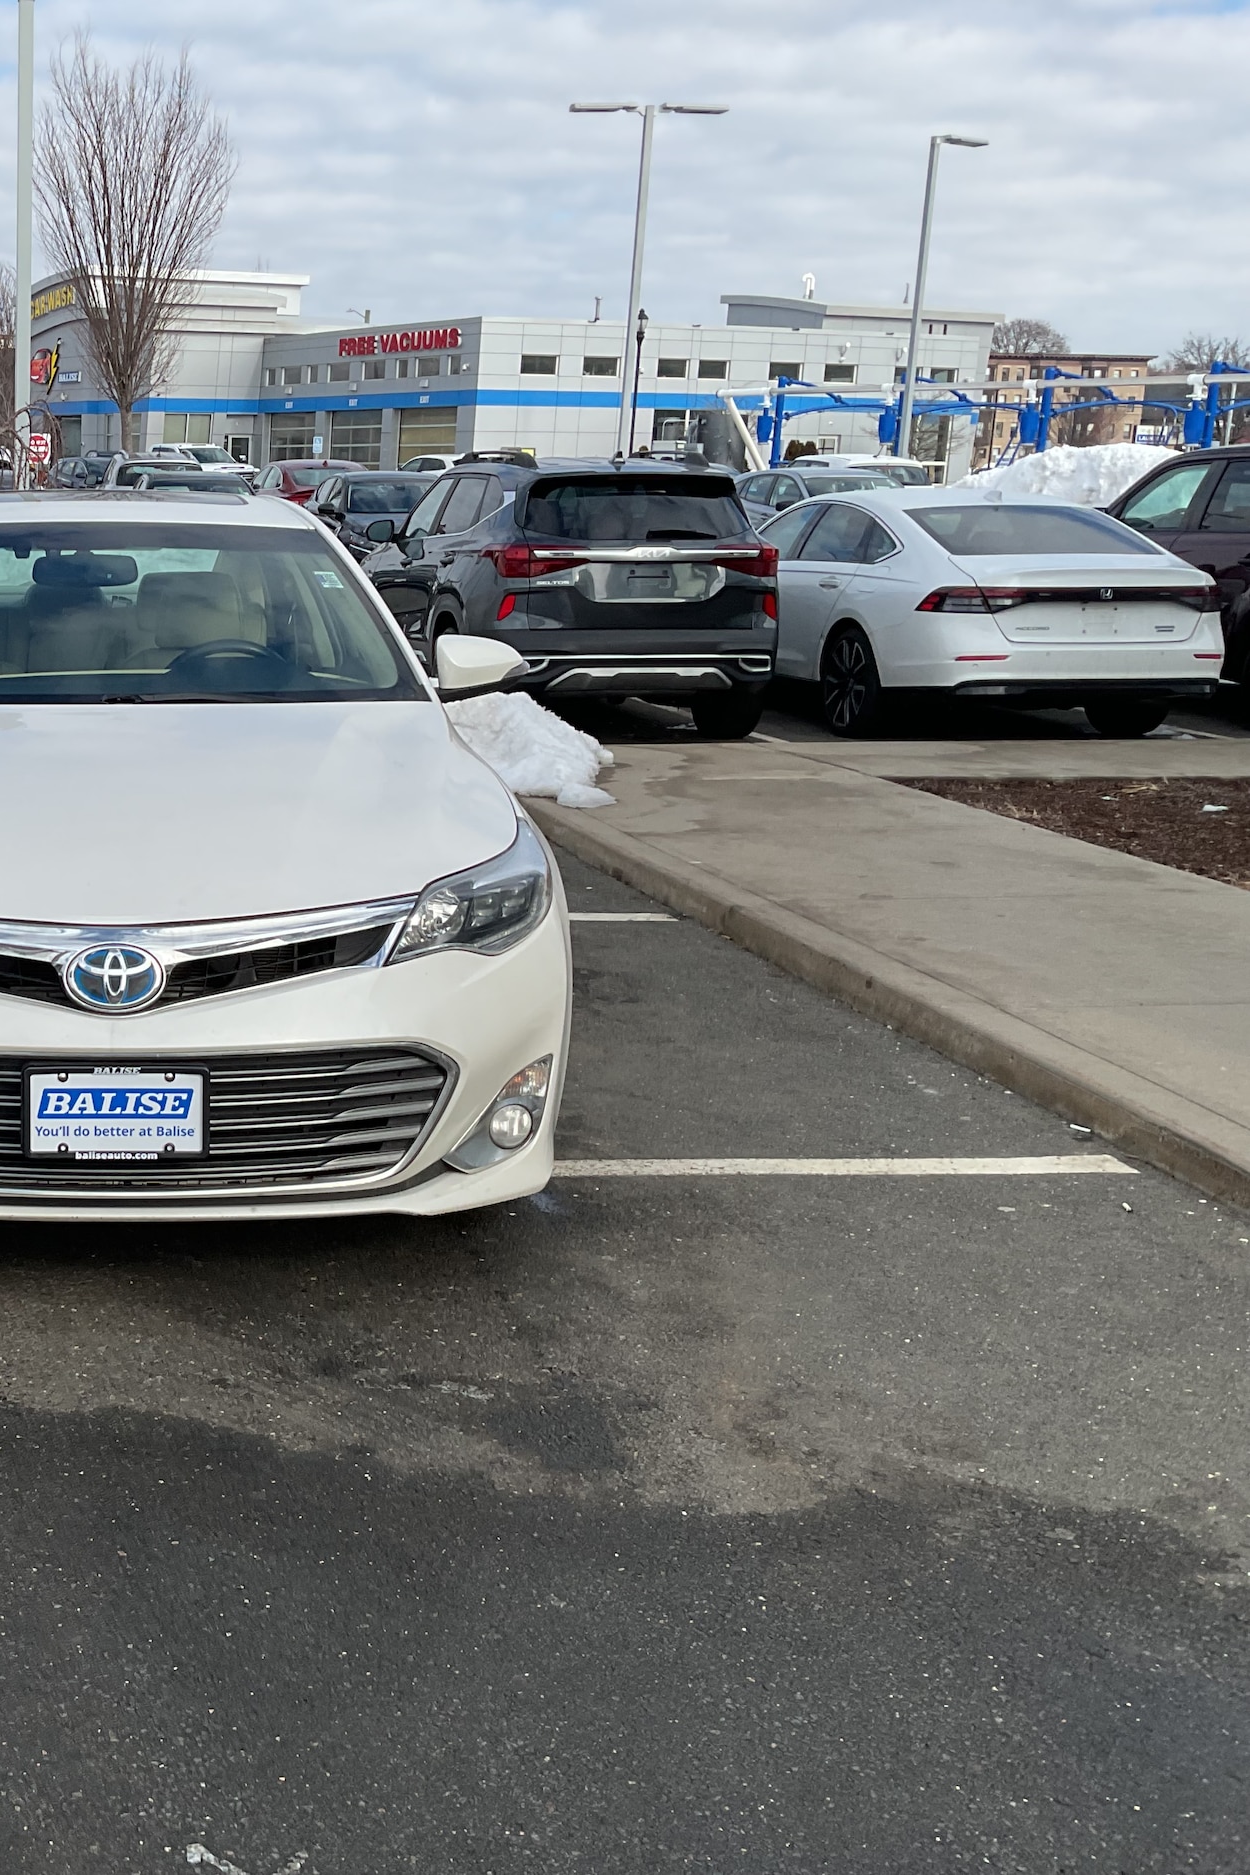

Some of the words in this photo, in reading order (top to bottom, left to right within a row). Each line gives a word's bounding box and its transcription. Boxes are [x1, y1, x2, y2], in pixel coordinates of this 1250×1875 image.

[47, 285, 75, 312] WASH
[338, 335, 379, 357] FREE
[380, 328, 462, 353] VACUUMS
[92, 1066, 142, 1075] BALISE
[43, 1092, 188, 1115] BALISE
[35, 1126, 69, 1137] You'll
[73, 1126, 90, 1137] do
[94, 1126, 135, 1137] better
[139, 1127, 152, 1137] at
[156, 1126, 195, 1137] Balise
[74, 1151, 158, 1160] baliseauto.com
